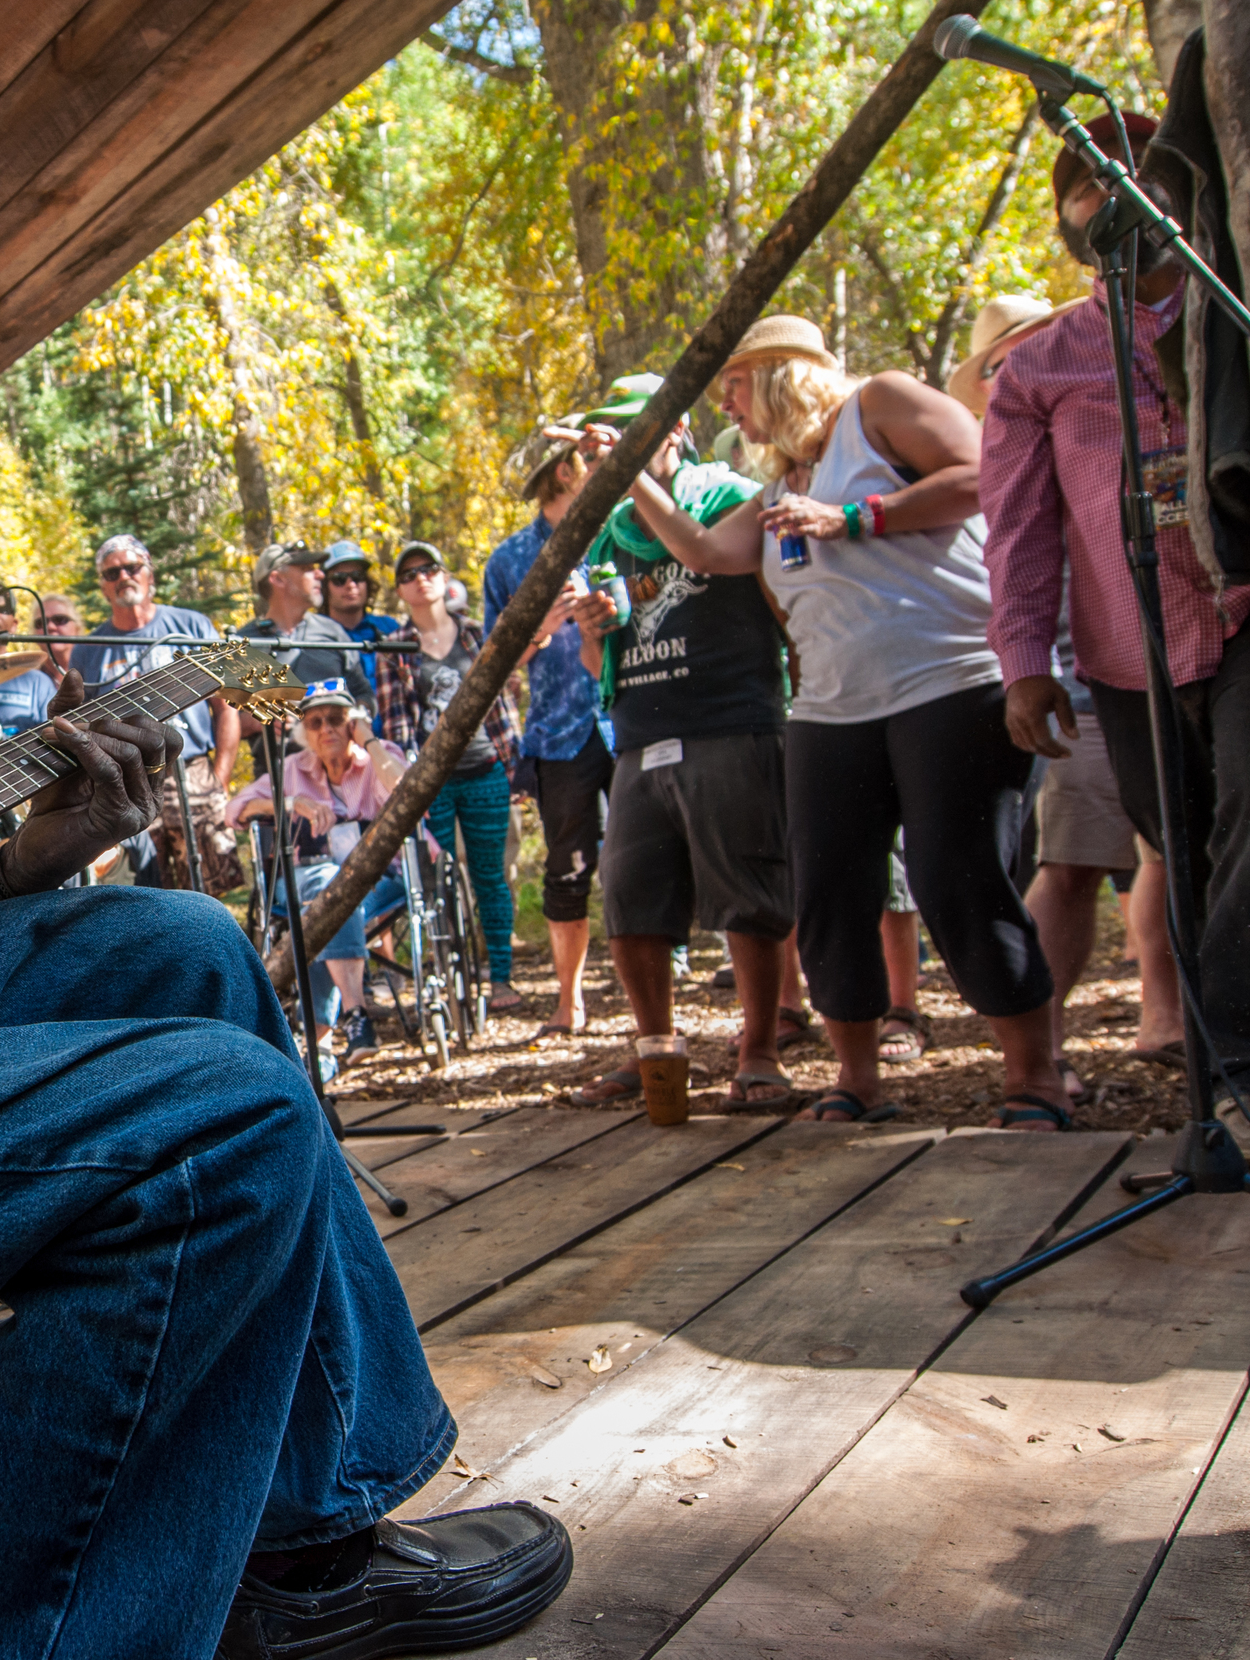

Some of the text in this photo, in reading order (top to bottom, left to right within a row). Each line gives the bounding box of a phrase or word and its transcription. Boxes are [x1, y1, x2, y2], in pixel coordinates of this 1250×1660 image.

[1156, 511, 1190, 524] CCES
[620, 637, 687, 669] ALOON
[673, 666, 690, 679] CO
